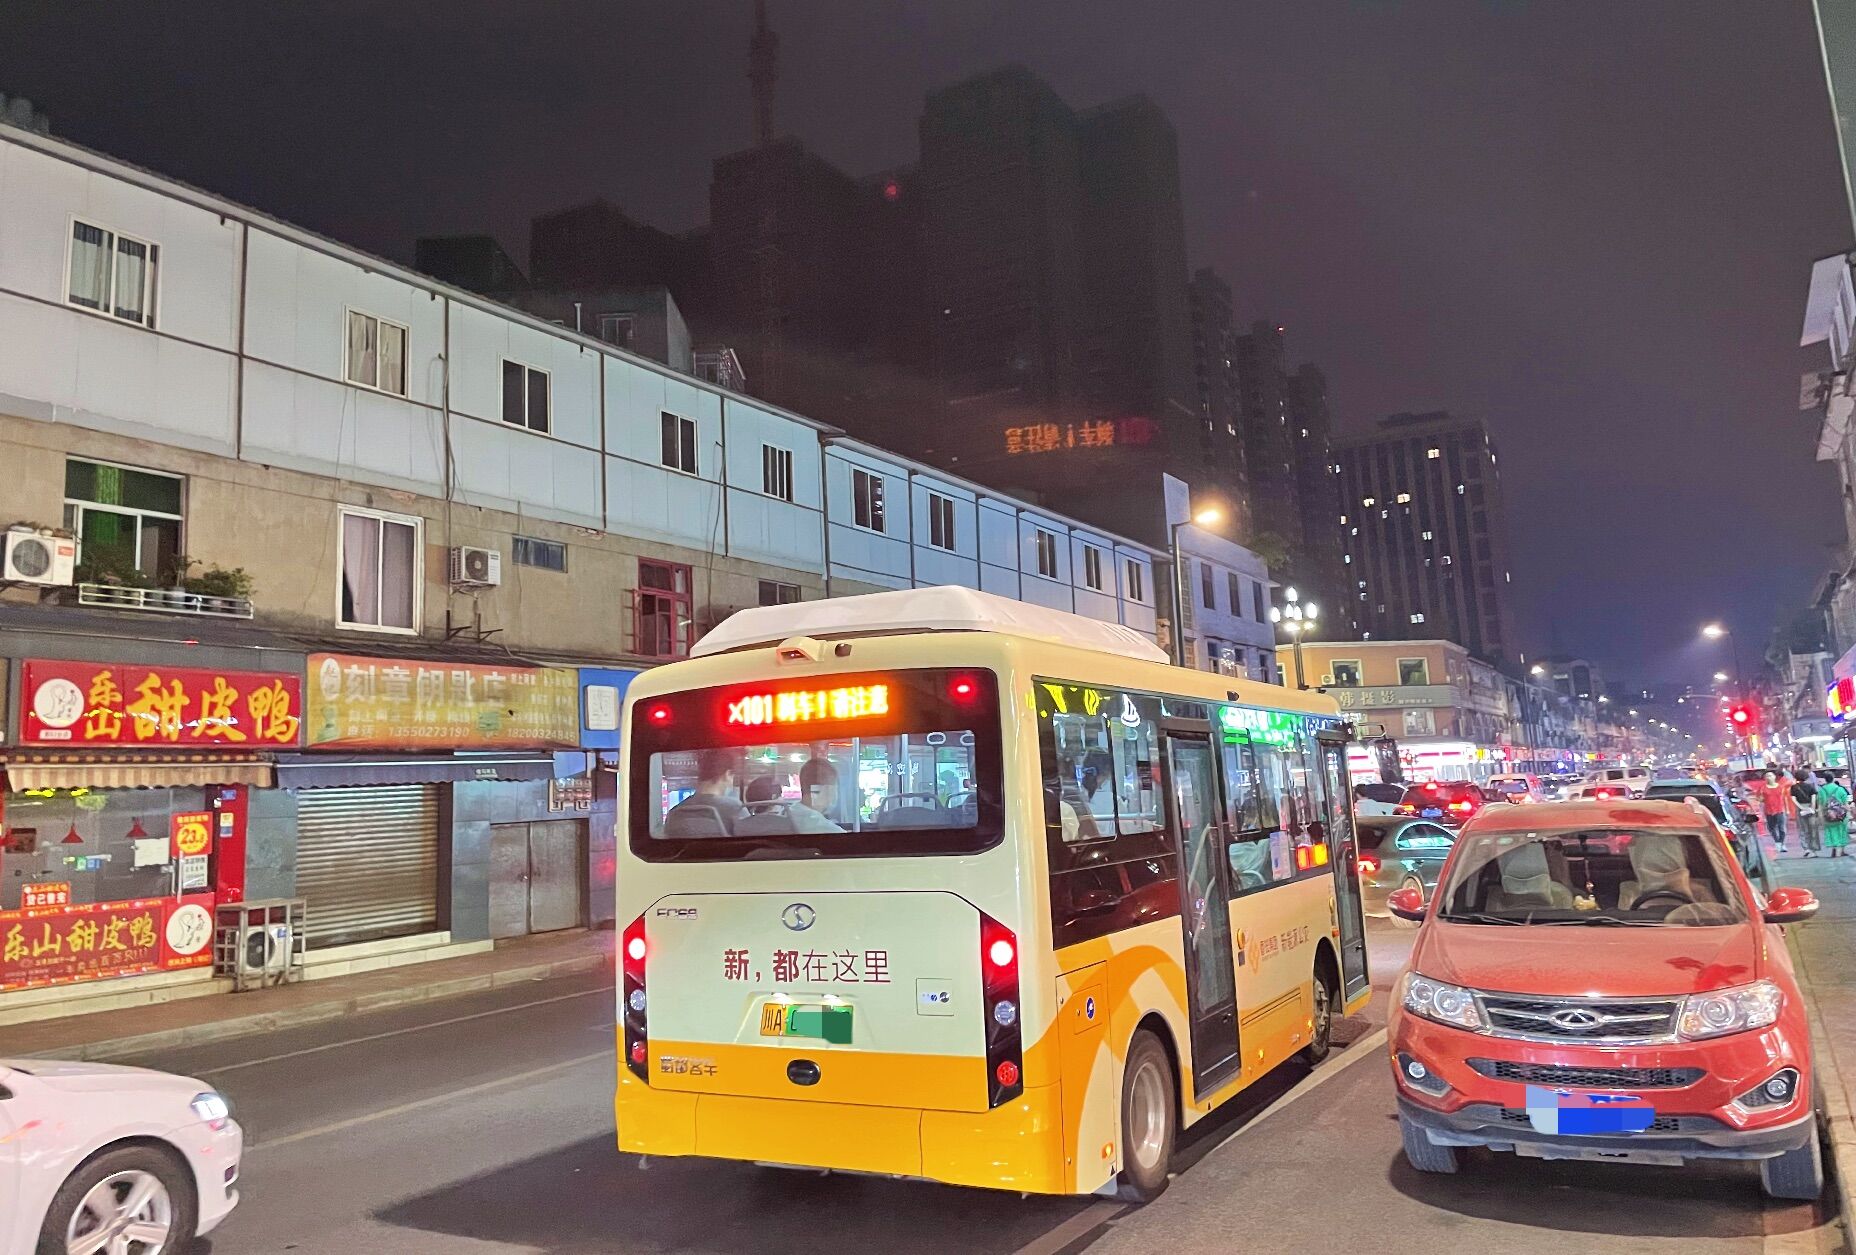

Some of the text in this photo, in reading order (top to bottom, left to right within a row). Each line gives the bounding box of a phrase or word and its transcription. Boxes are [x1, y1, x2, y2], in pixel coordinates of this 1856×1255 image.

[4, 911, 157, 963] 乐山甜皮鸭
